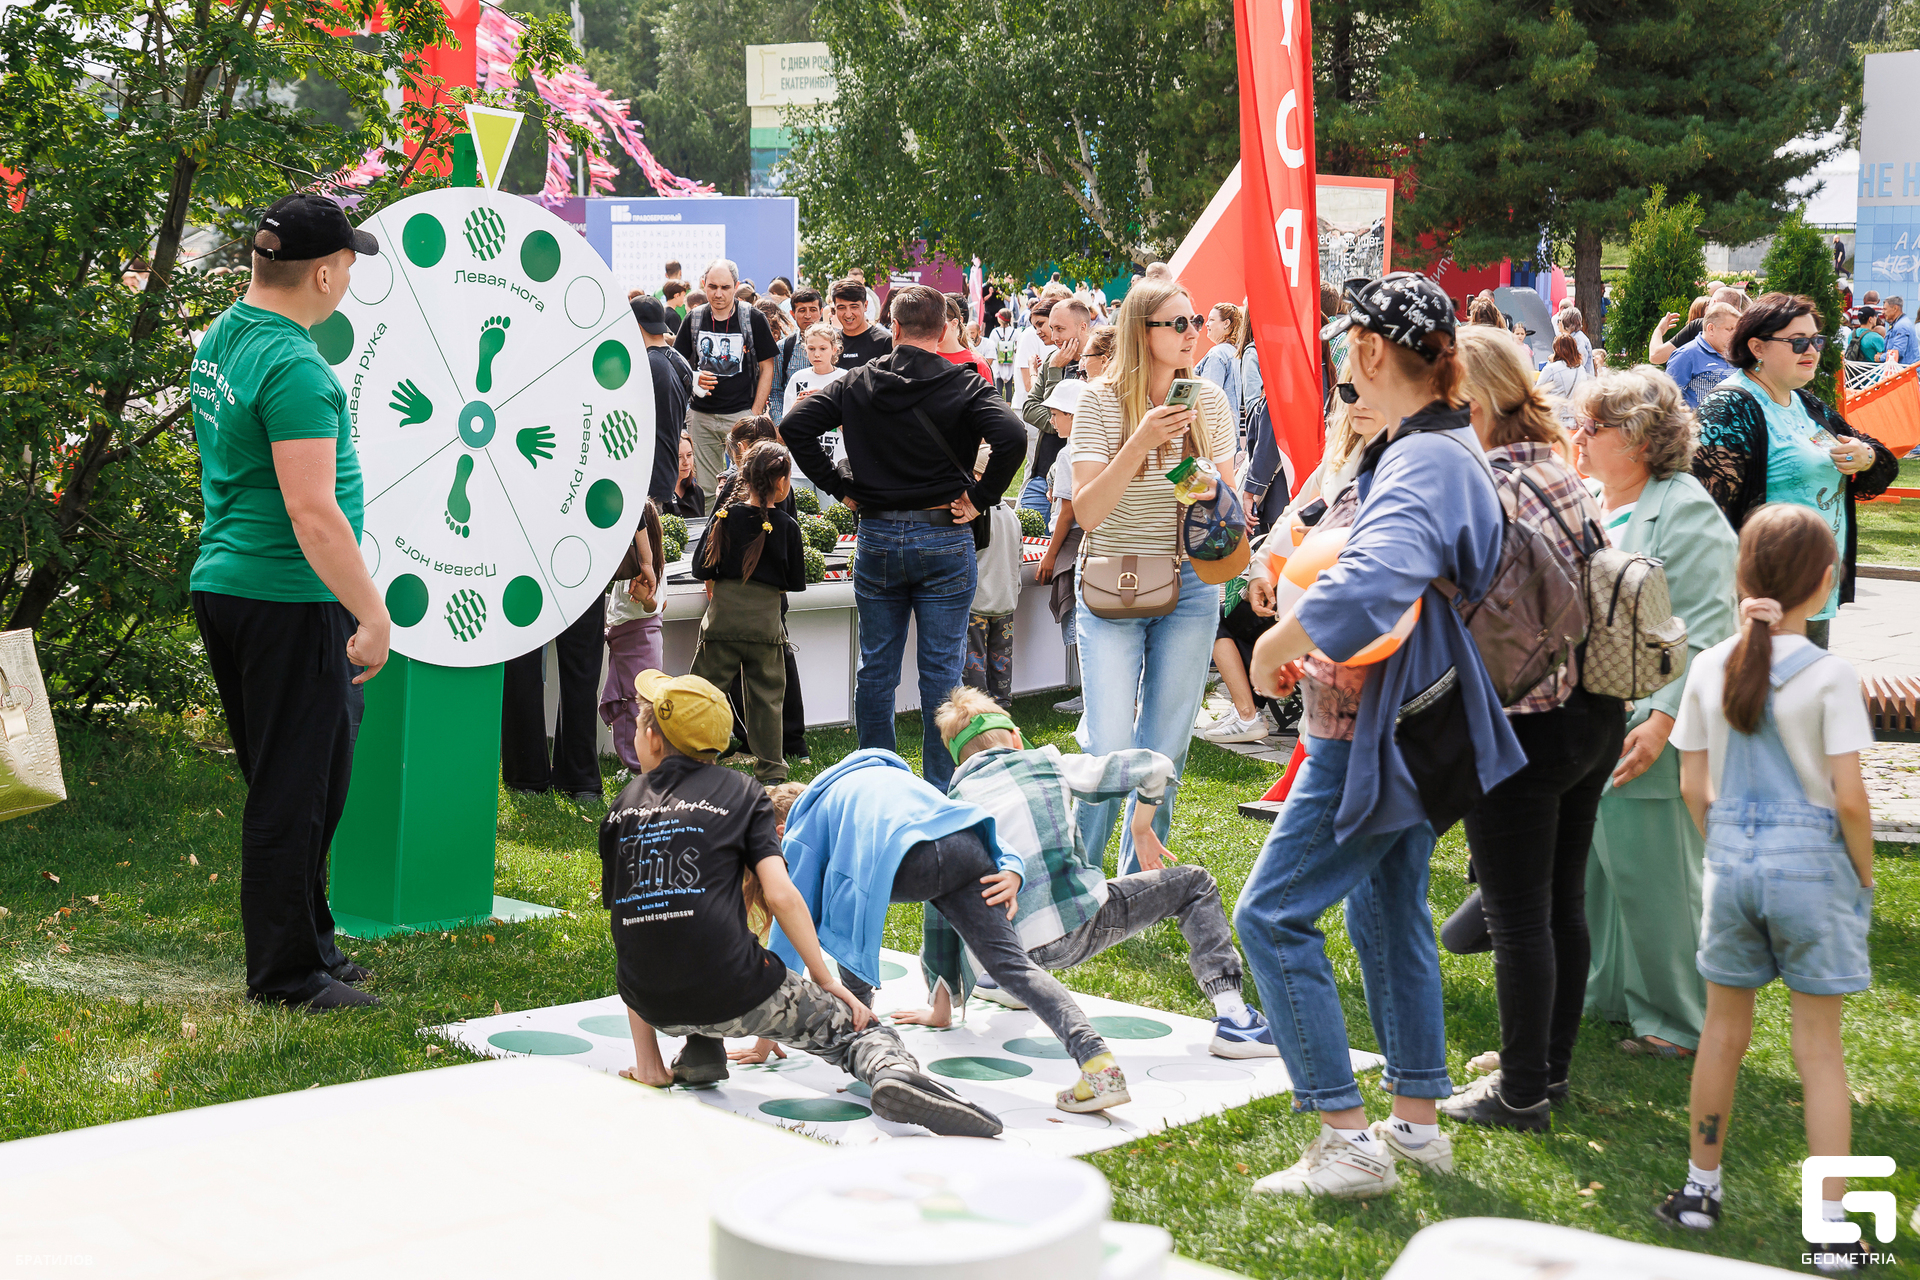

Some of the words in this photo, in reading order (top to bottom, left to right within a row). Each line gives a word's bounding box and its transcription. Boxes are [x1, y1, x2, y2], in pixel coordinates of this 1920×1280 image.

[781, 57, 786, 70] С
[788, 56, 810, 72] ДНЕМ
[1858, 162, 1894, 198] НЕ
[454, 270, 507, 289] Левая
[510, 283, 545, 313] нога
[350, 373, 364, 450] равая
[359, 323, 388, 370] рука
[579, 402, 593, 466] Левая
[560, 469, 584, 515] рука
[395, 536, 431, 567] нога
[433, 560, 497, 578] Правая
